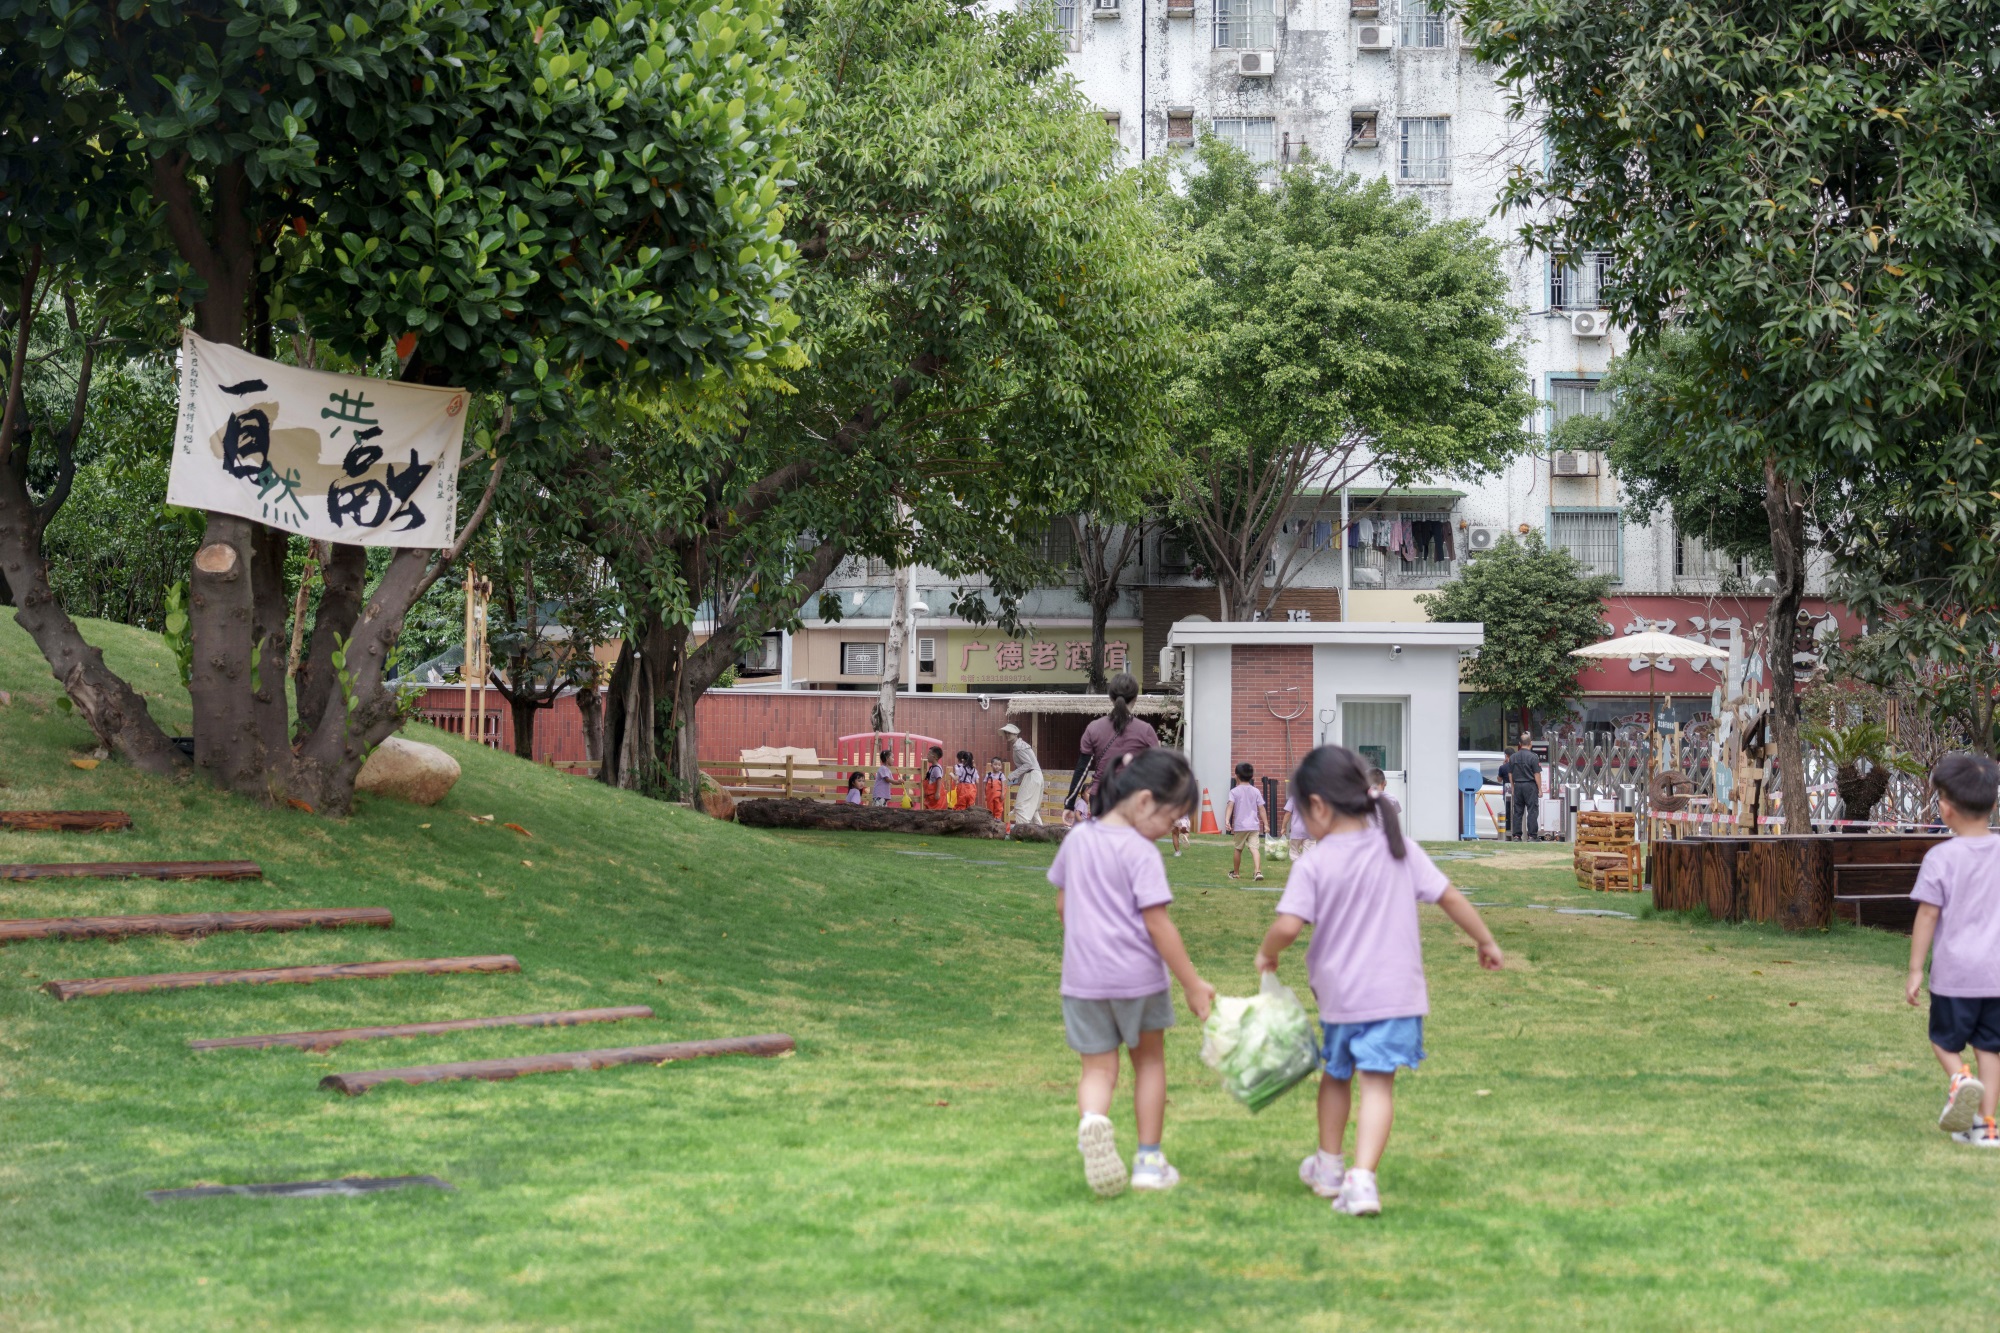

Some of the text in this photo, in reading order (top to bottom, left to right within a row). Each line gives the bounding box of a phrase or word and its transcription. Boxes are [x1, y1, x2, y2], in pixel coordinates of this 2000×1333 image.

[960, 640, 1129, 672] 广德老酒馆
